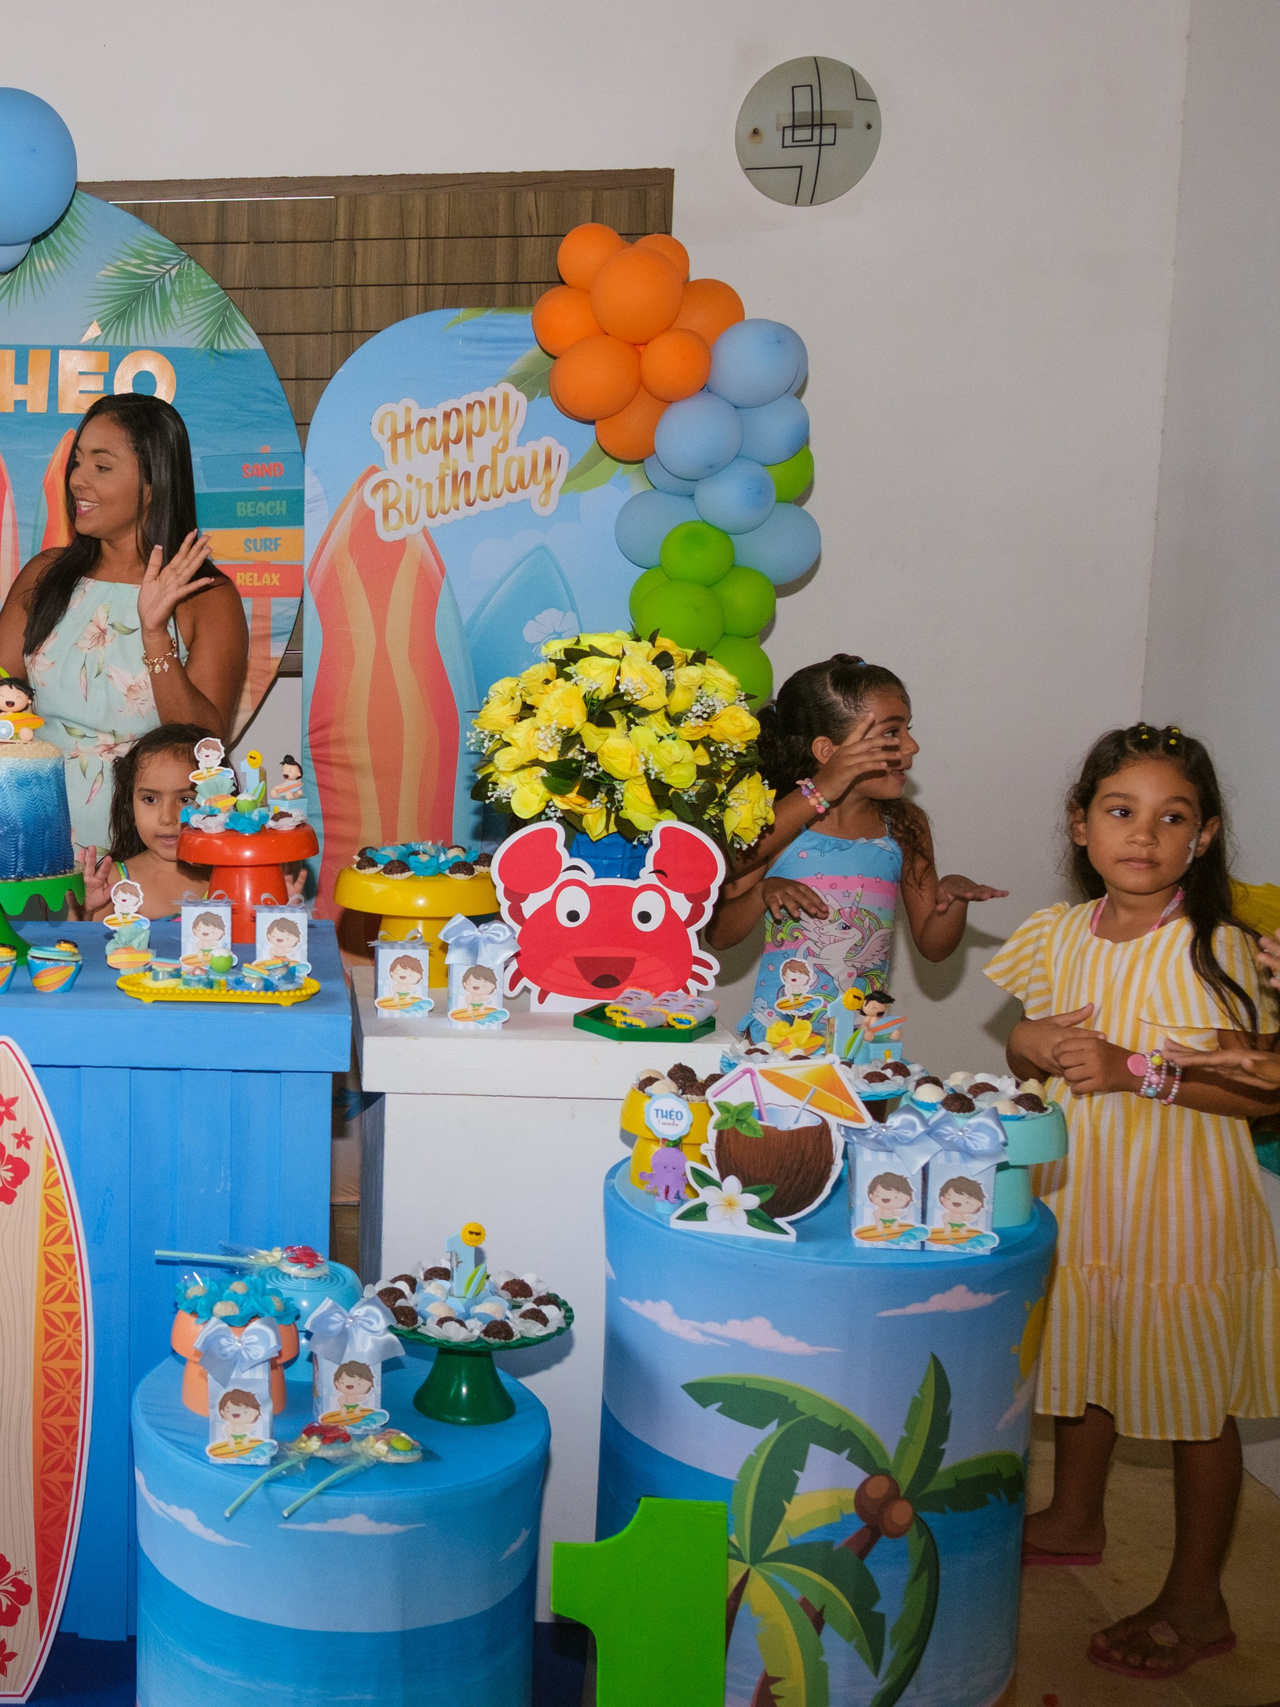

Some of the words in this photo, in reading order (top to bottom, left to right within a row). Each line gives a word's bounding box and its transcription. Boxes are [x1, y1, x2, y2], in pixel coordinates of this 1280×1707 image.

[378, 391, 519, 470] Happy
[242, 462, 284, 478] SAND
[370, 445, 561, 532] Birthday
[236, 500, 286, 517] BEACH
[244, 537, 281, 552] SURF
[236, 572, 280, 586] RELAX
[654, 1107, 683, 1121] THÉO
